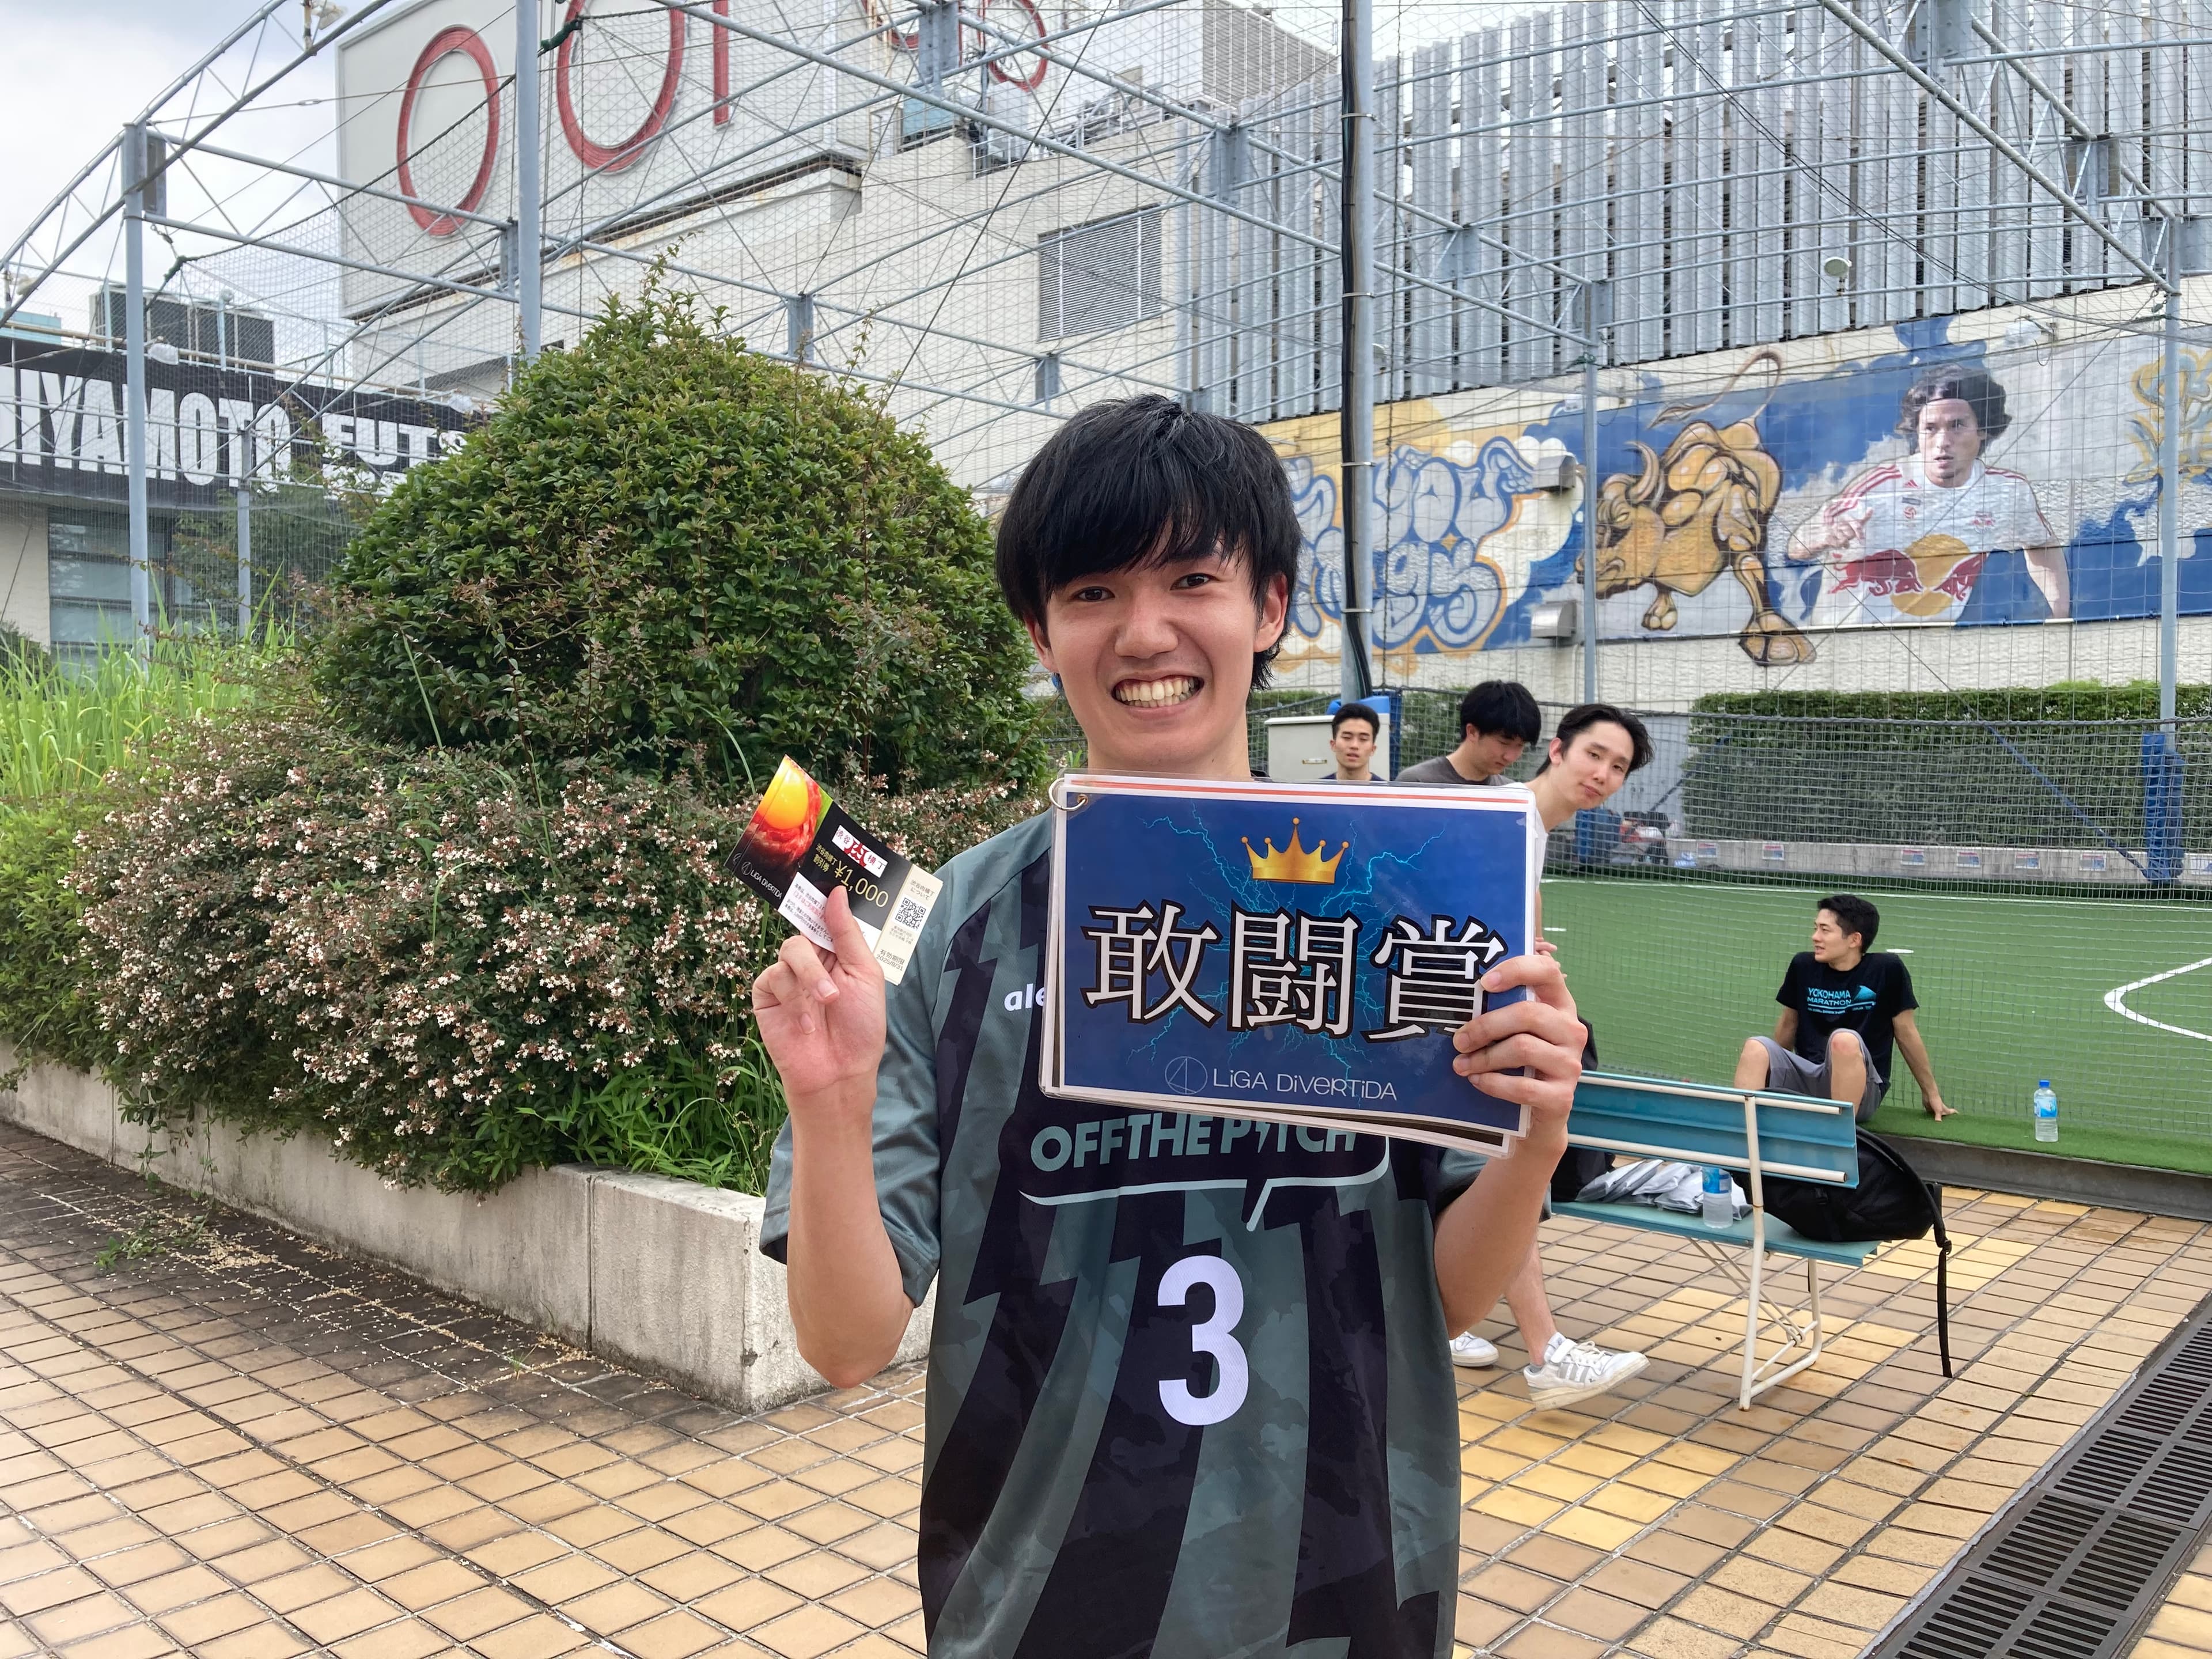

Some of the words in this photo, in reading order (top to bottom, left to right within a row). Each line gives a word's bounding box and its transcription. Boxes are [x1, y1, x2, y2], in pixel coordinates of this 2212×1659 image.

[834, 861, 889, 908] ¥1,000
[1084, 902, 1505, 1042] 敢闘賞
[1808, 987, 1851, 999] YOKOHAMA
[1806, 997, 1852, 1006] MARATHON
[1157, 1254, 1249, 1426] 3
